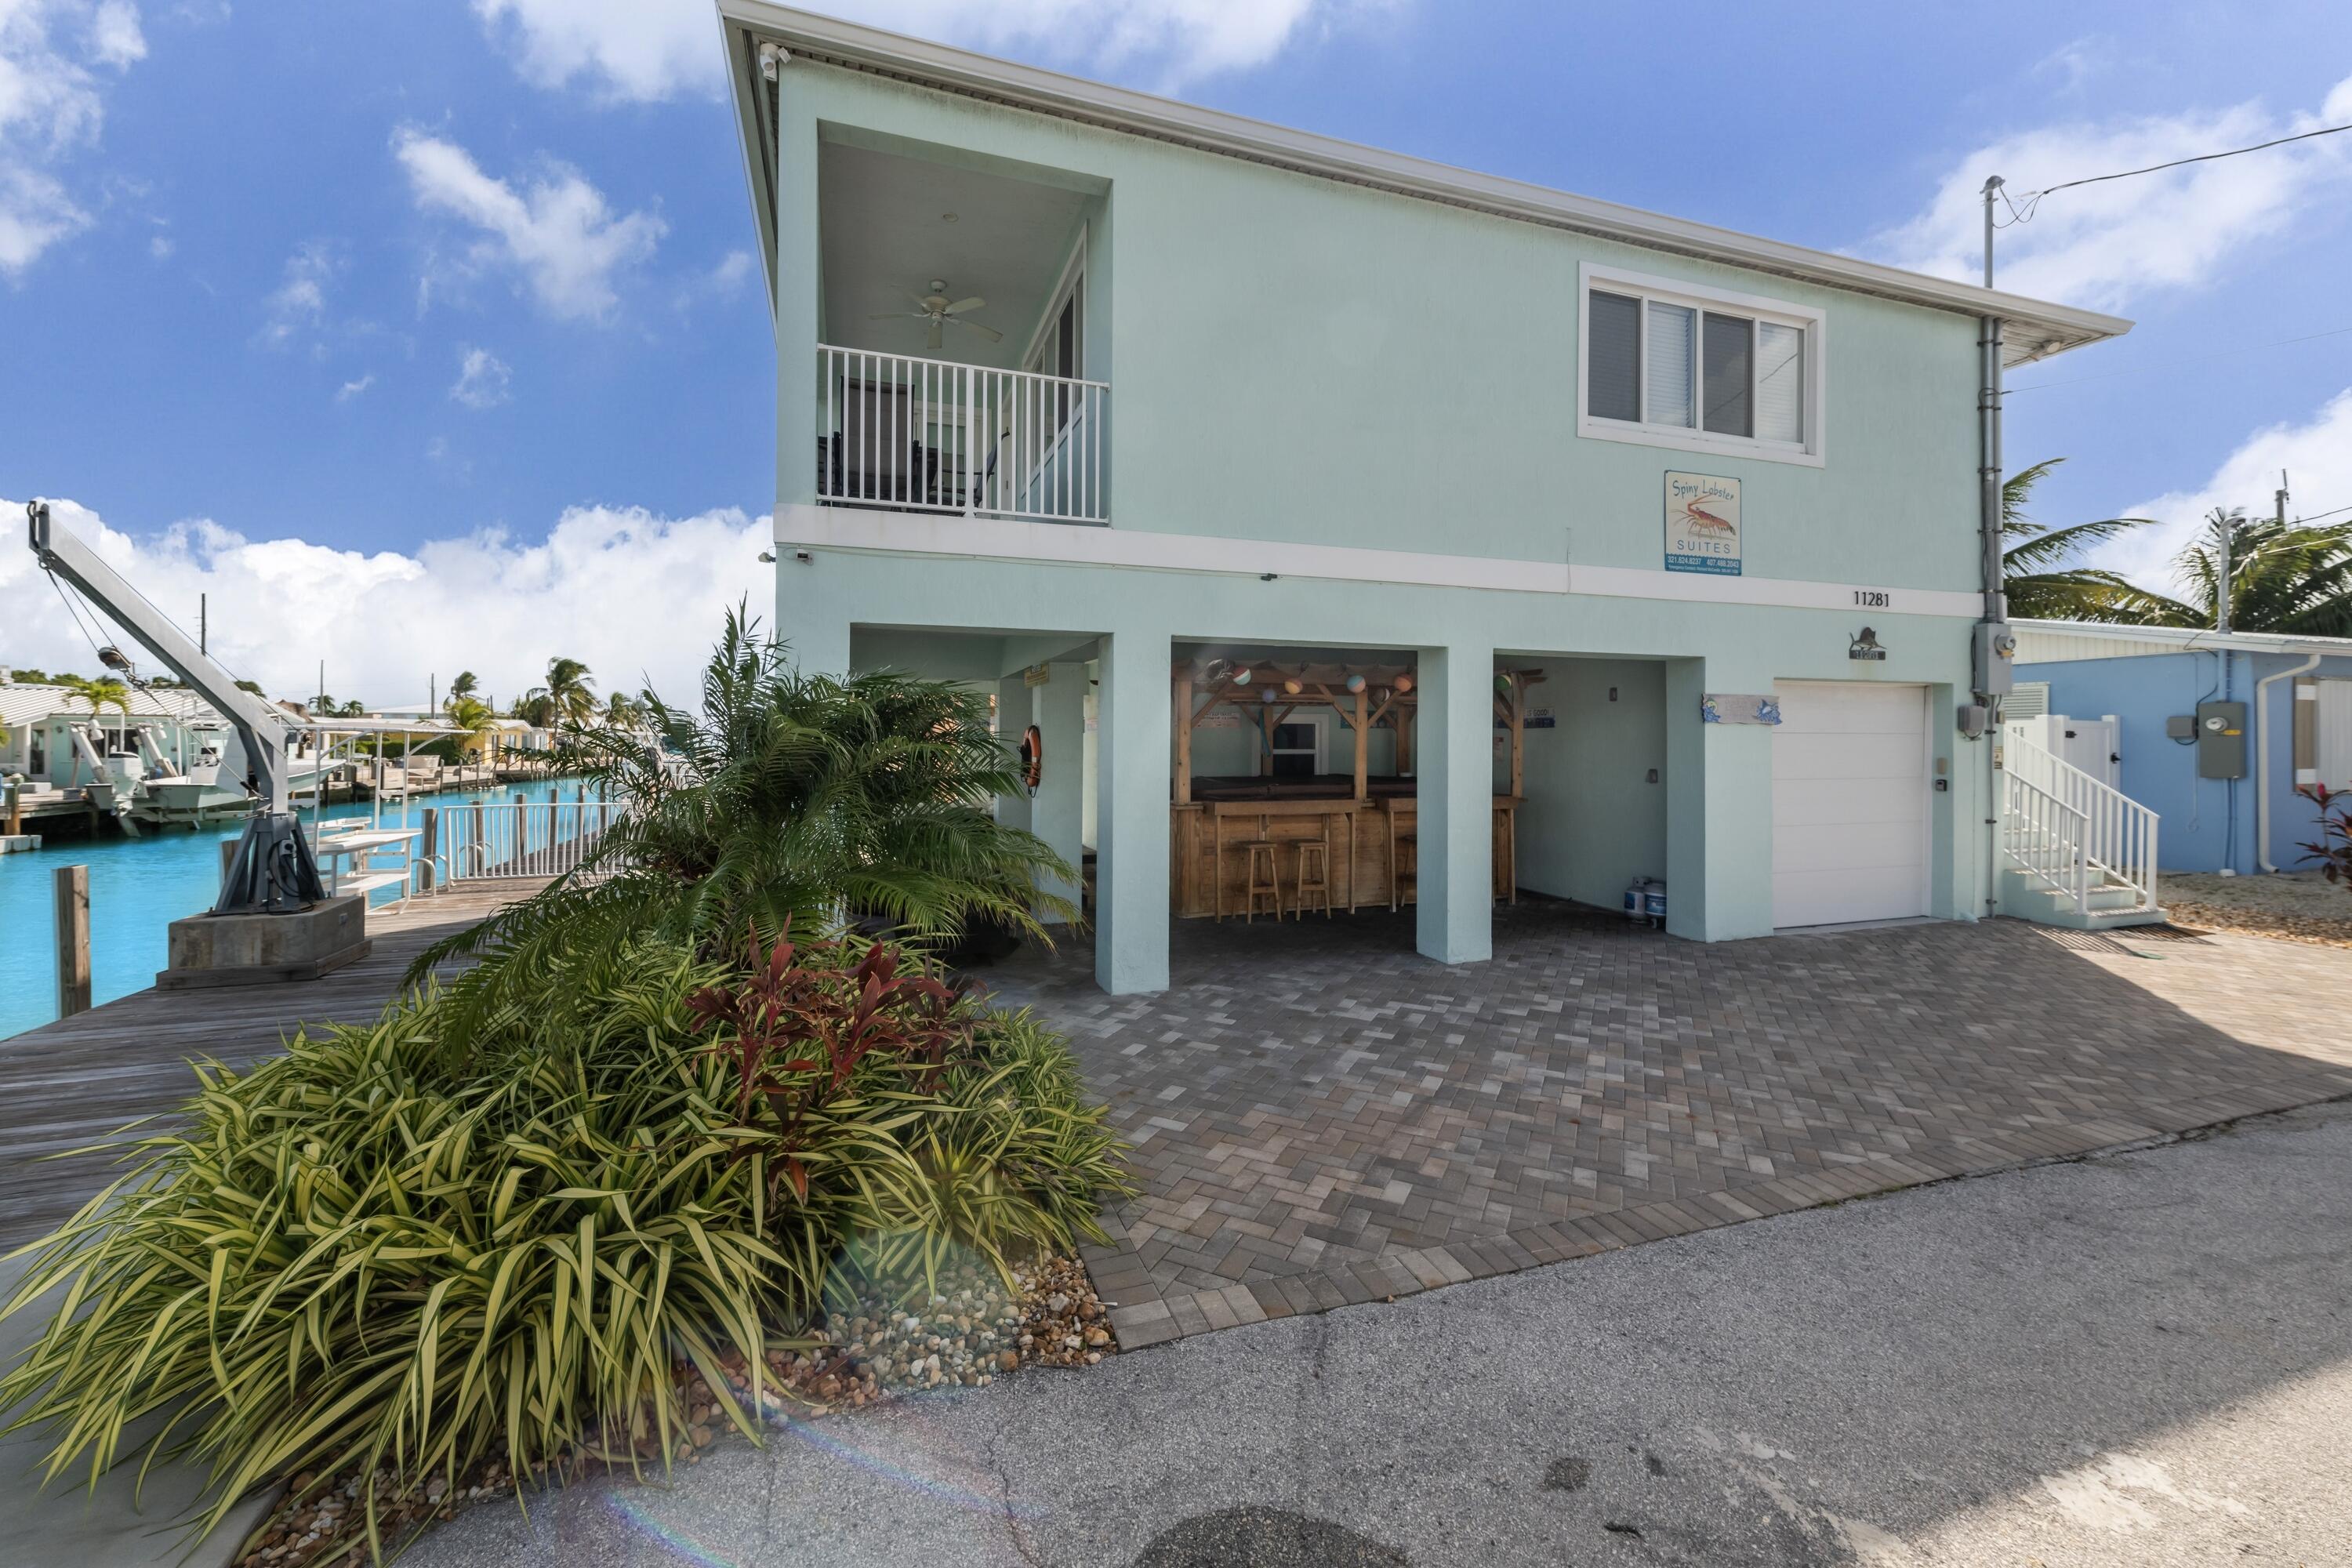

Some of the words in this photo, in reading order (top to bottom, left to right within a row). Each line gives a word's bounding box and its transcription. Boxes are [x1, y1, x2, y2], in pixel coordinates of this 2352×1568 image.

[1672, 480, 1699, 499] Spiny
[1702, 479, 1734, 501] Lobster
[1677, 539, 1730, 554] SUITES
[1854, 590, 1889, 607] 11281
